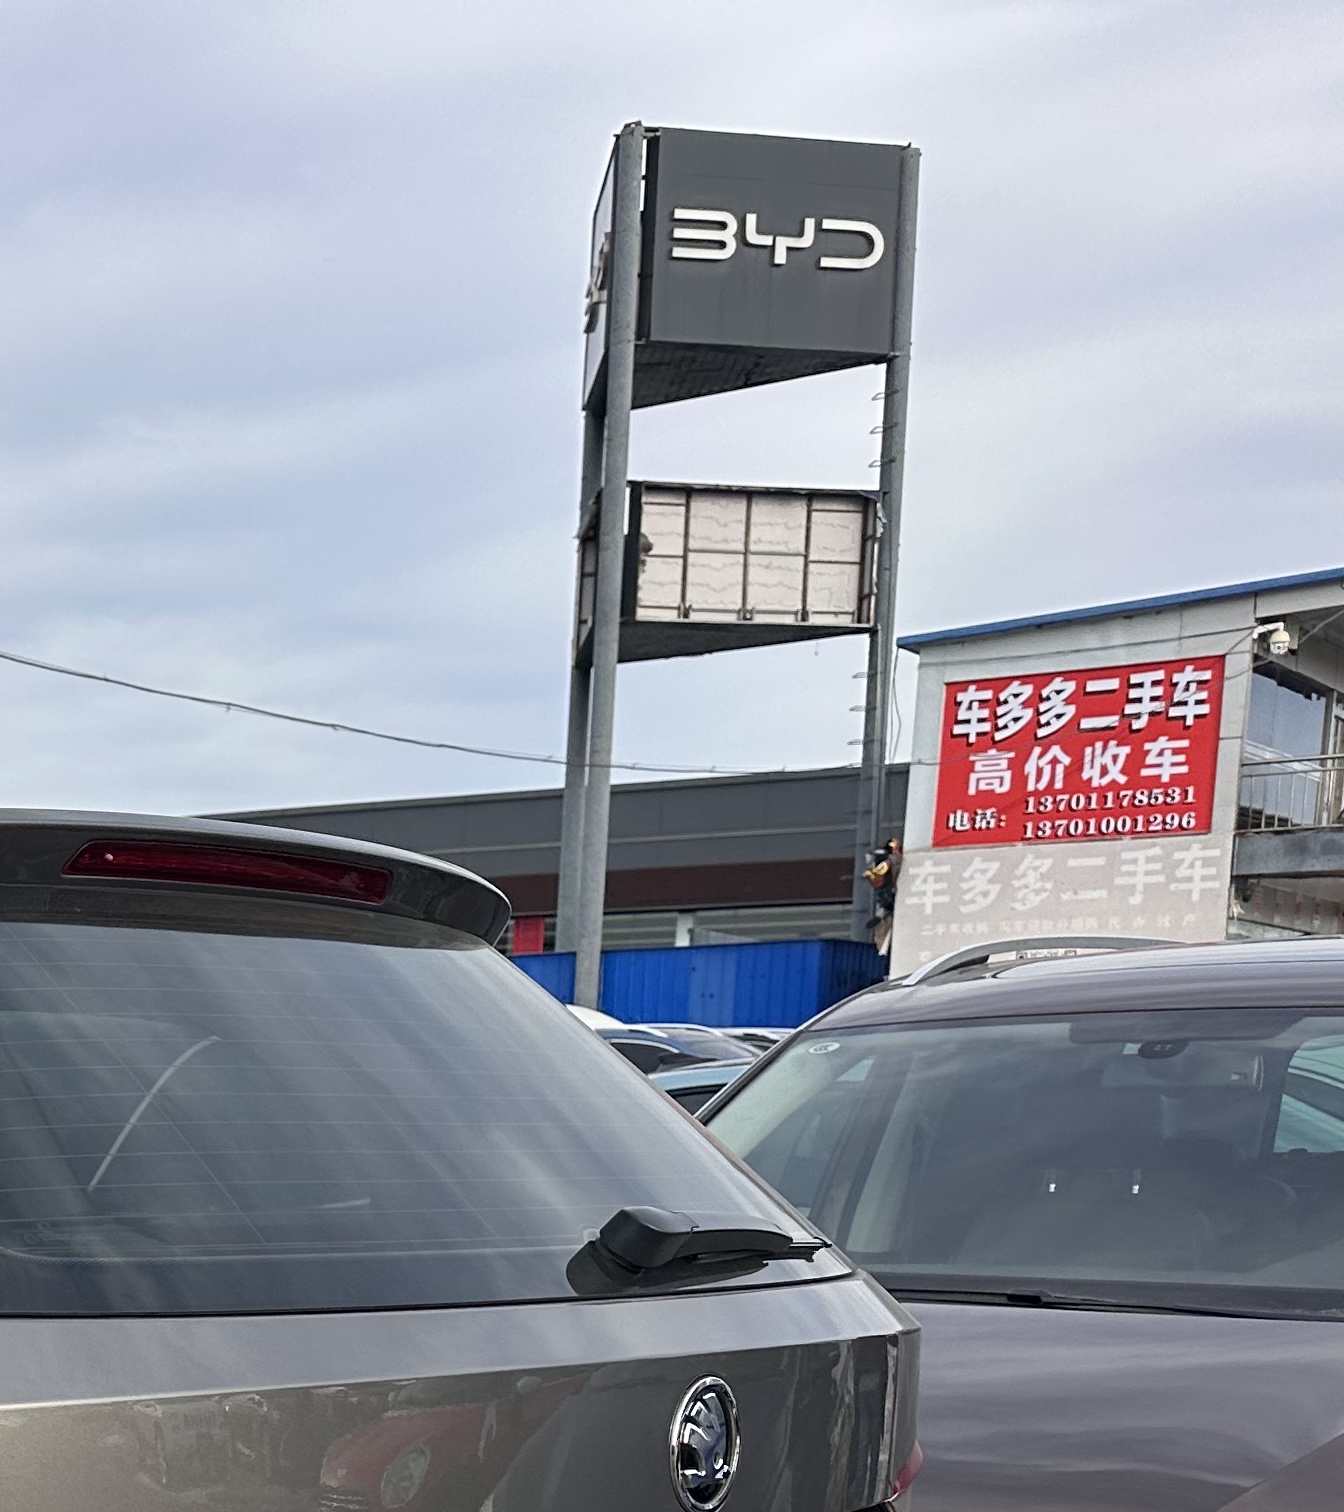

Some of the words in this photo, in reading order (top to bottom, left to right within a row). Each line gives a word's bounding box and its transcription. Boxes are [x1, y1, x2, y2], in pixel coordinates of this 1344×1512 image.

[671, 207, 885, 270] BYD
[951, 664, 1212, 746] 车多多二手车
[967, 735, 1191, 796] 高价收车
[1022, 810, 1198, 840] 13701001296
[1023, 785, 1198, 815] 13701178531
[904, 843, 1221, 916] 车多多二手车
